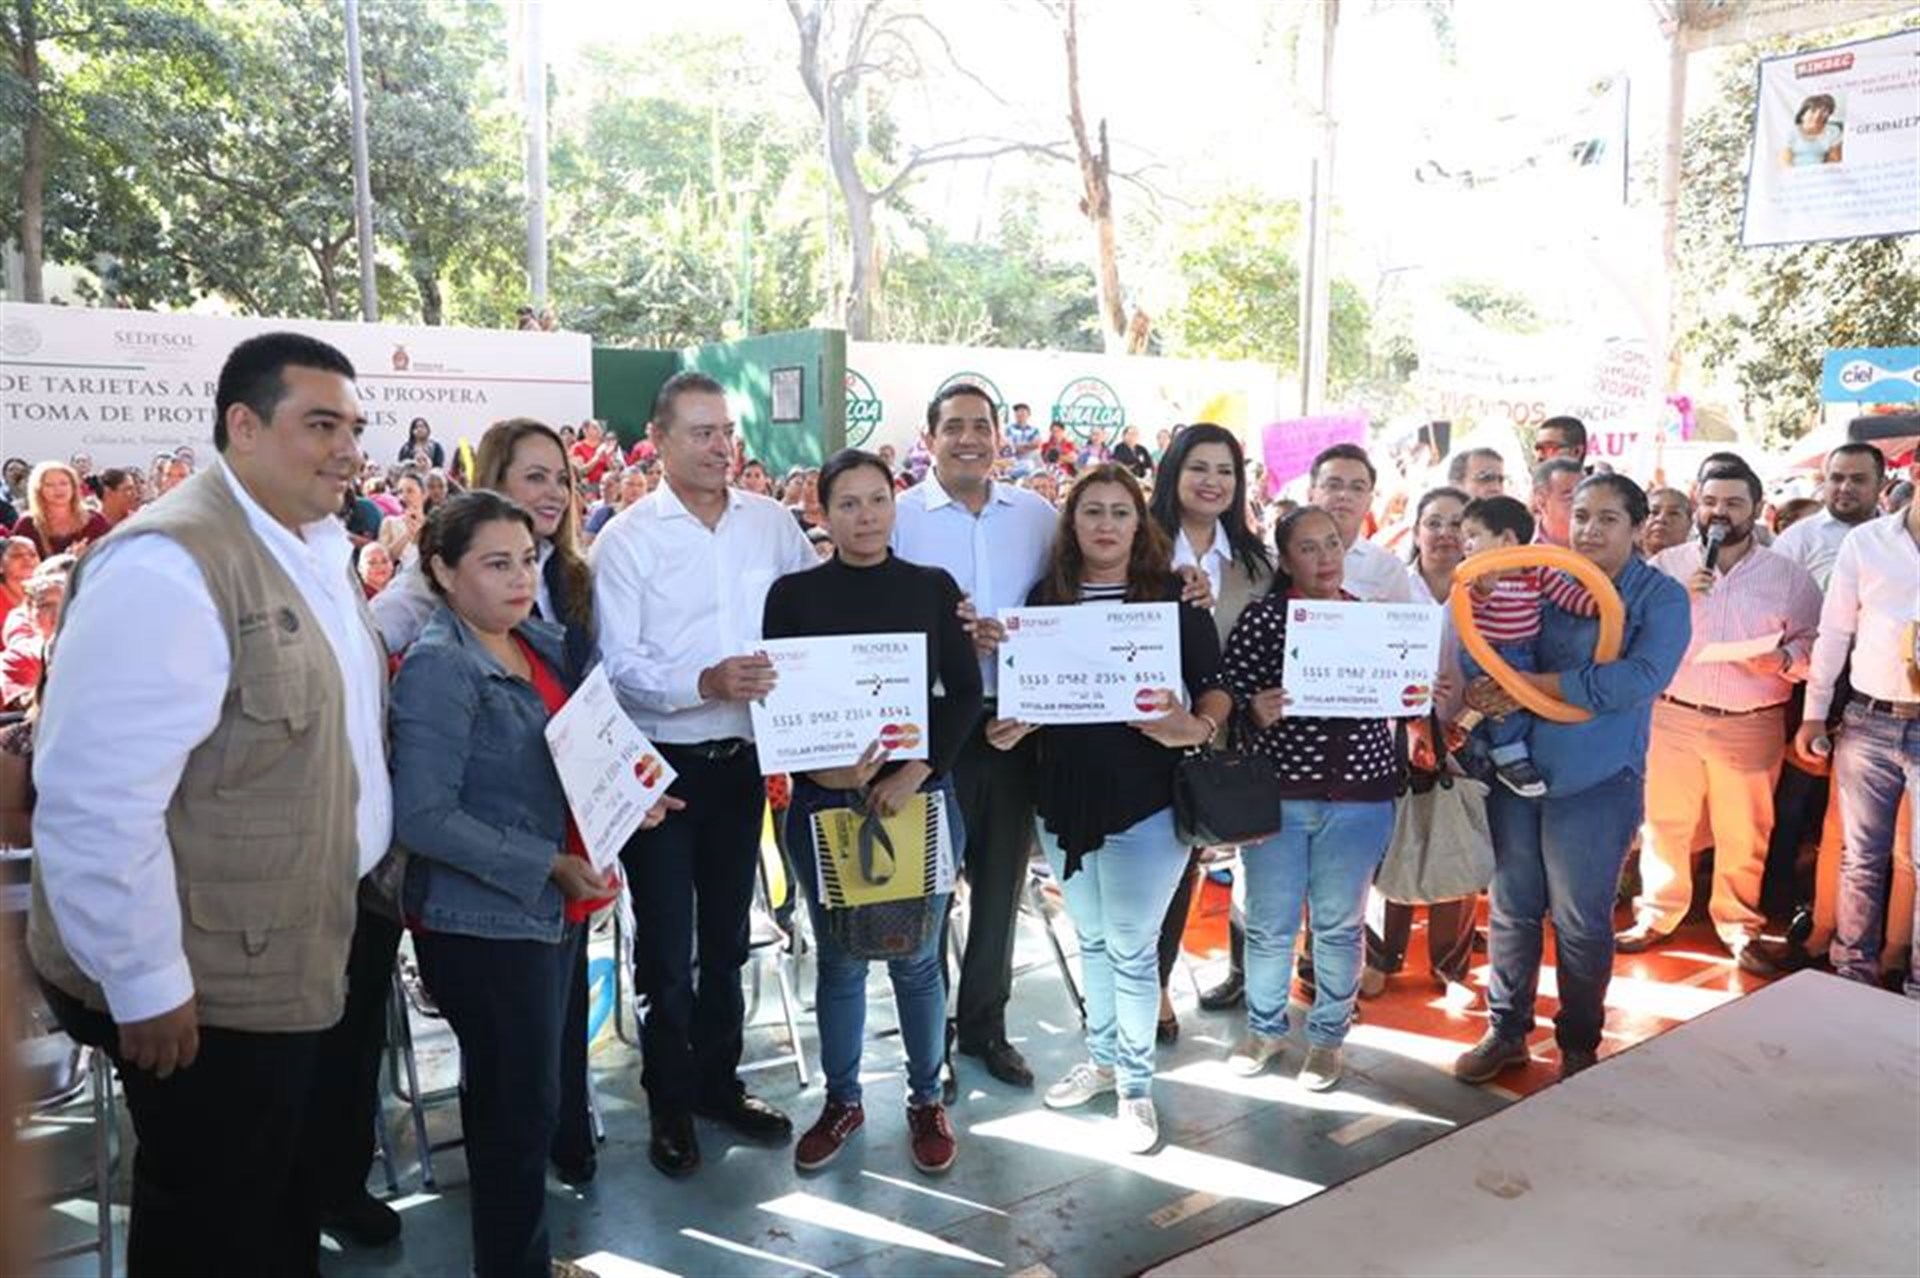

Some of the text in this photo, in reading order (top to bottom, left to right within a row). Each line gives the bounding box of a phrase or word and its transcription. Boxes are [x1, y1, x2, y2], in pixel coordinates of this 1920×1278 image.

[114, 331, 196, 347] SEDESOL
[1842, 365, 1873, 384] ciel
[40, 377, 169, 396] TARJETAS
[178, 382, 194, 397] A
[383, 387, 488, 404] PROSPERA
[6, 403, 90, 422] TOMA
[100, 405, 134, 422] DE
[144, 407, 217, 424] PROT
